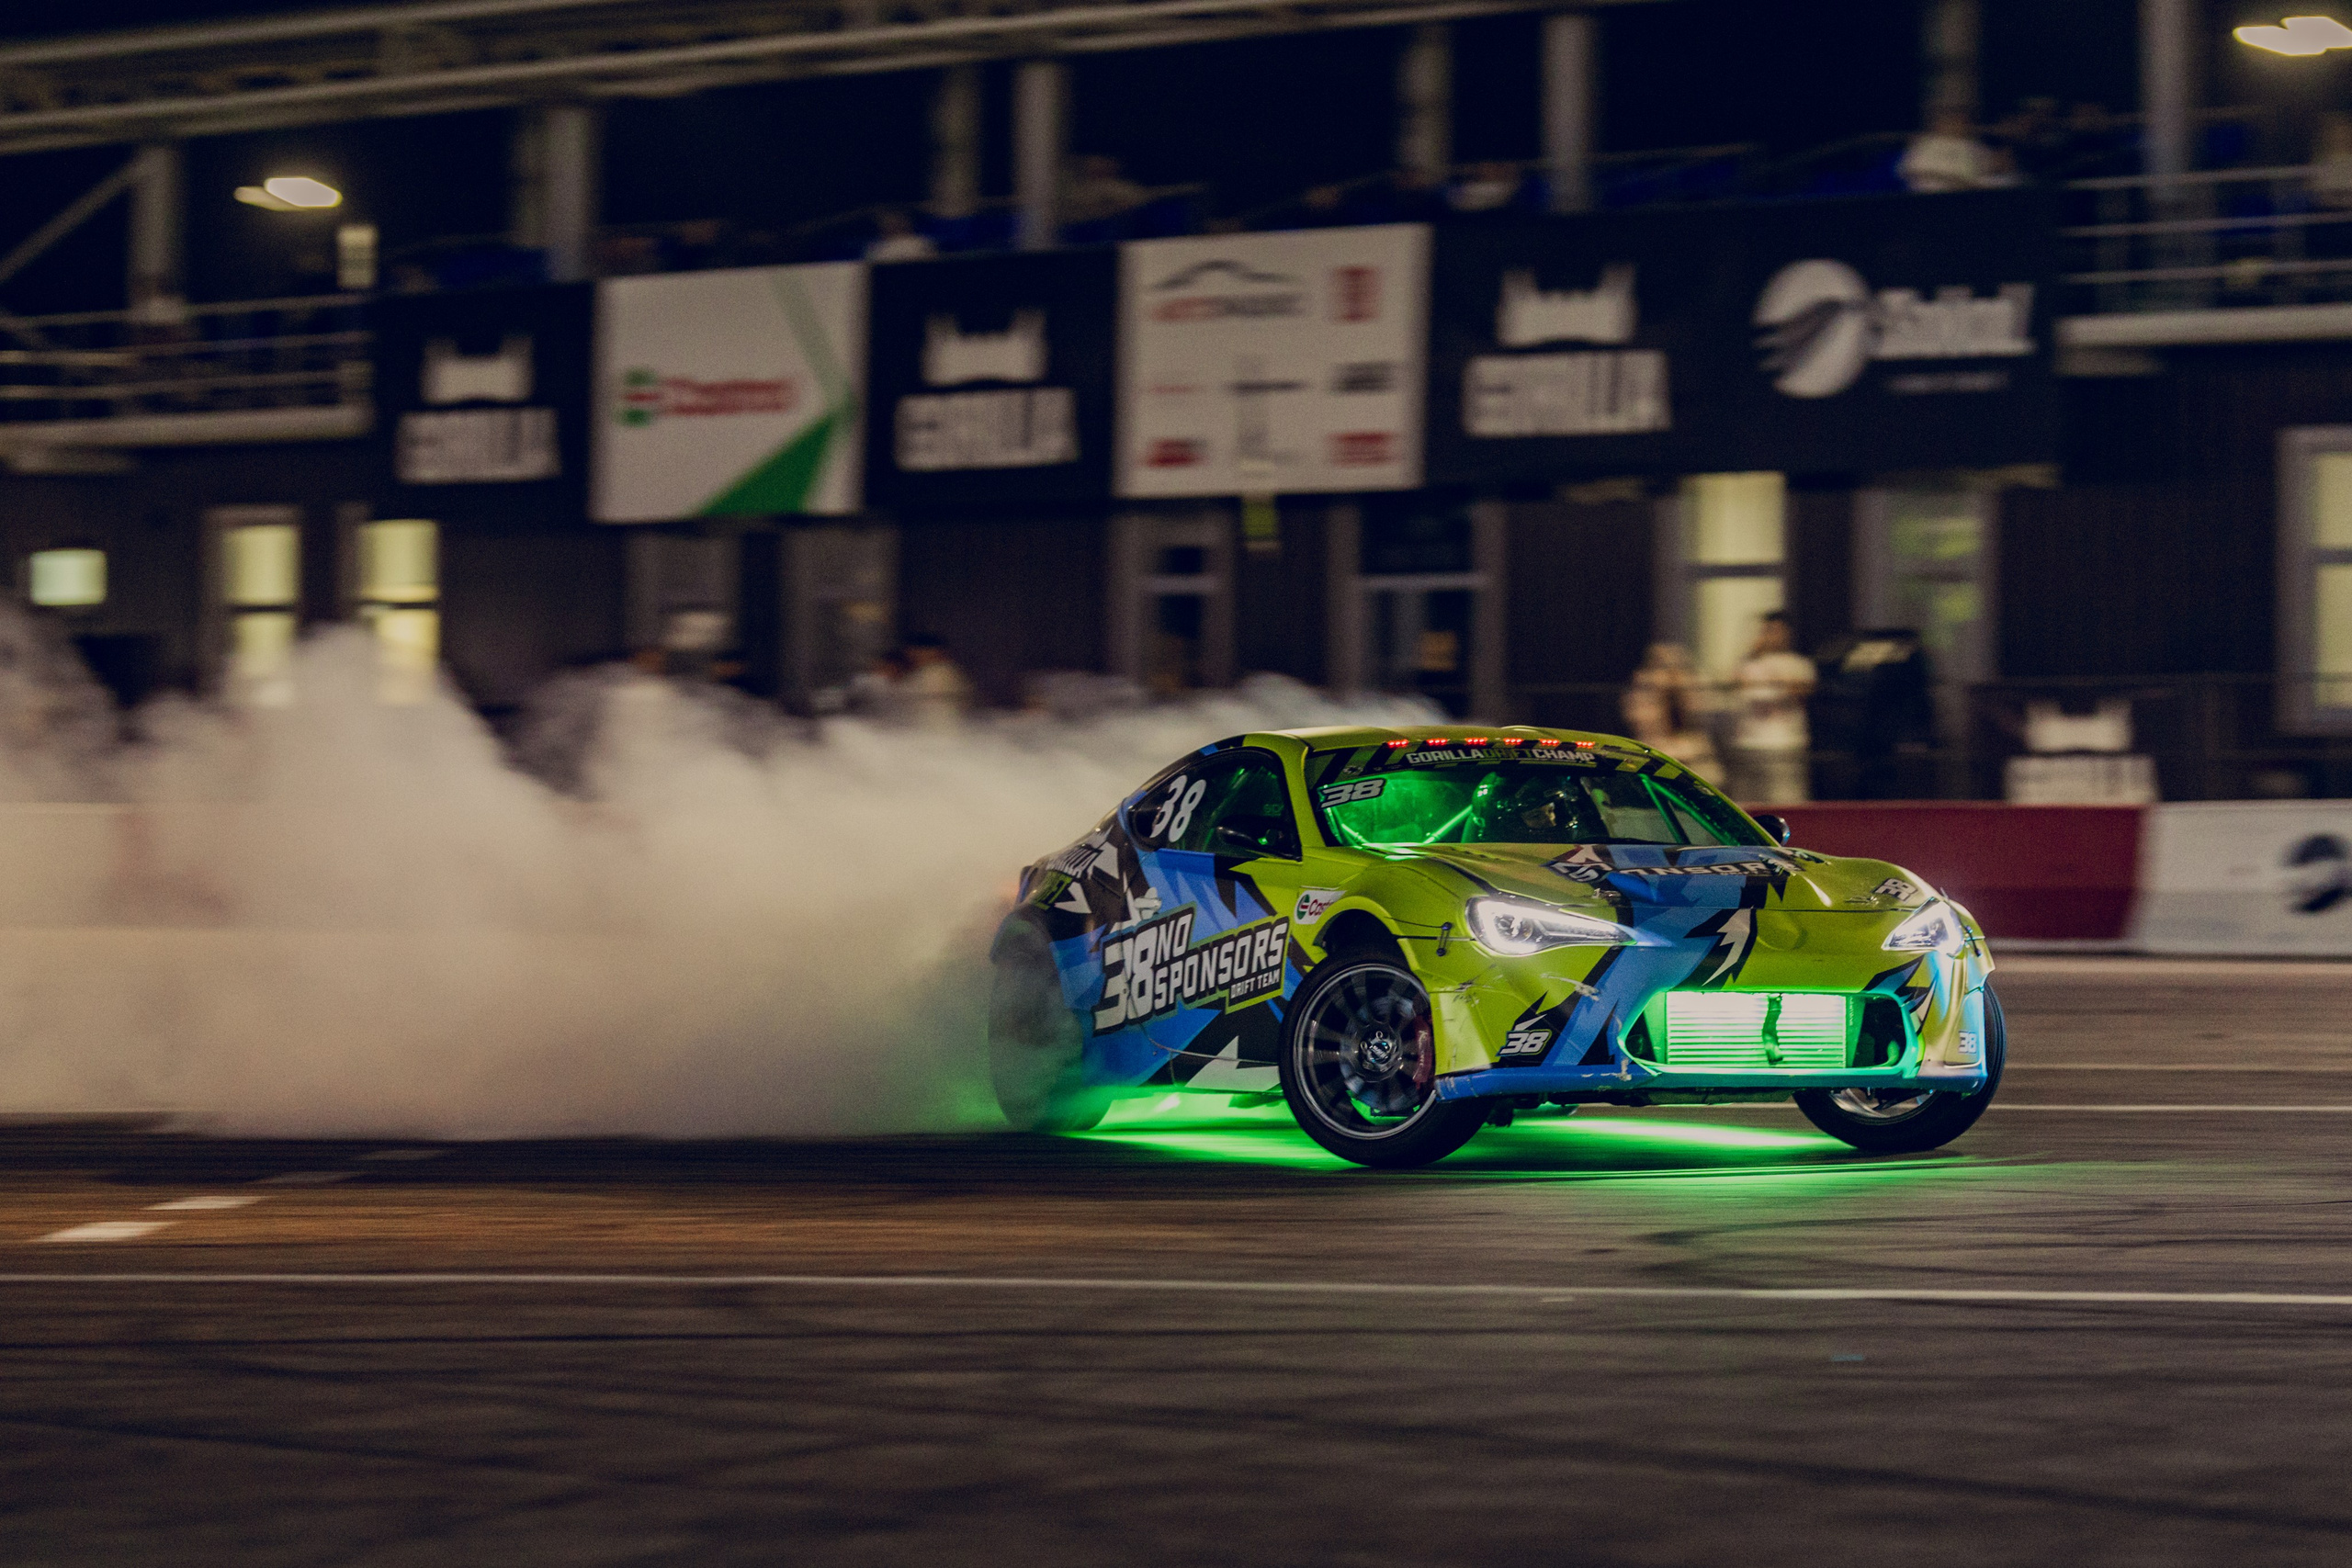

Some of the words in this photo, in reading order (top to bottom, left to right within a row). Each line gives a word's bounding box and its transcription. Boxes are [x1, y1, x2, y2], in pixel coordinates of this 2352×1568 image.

[1321, 779, 1384, 807] 38
[1149, 774, 1206, 842] 38
[1874, 878, 1917, 901] 38
[1094, 926, 1159, 1030] 38
[1155, 913, 1193, 965] NO
[1153, 922, 1288, 1010] SPONSORS
[1231, 976, 1256, 998] DRIFT
[1257, 968, 1281, 989] TEAM
[1499, 1032, 1550, 1055] 38
[1958, 1032, 1976, 1053] 38
